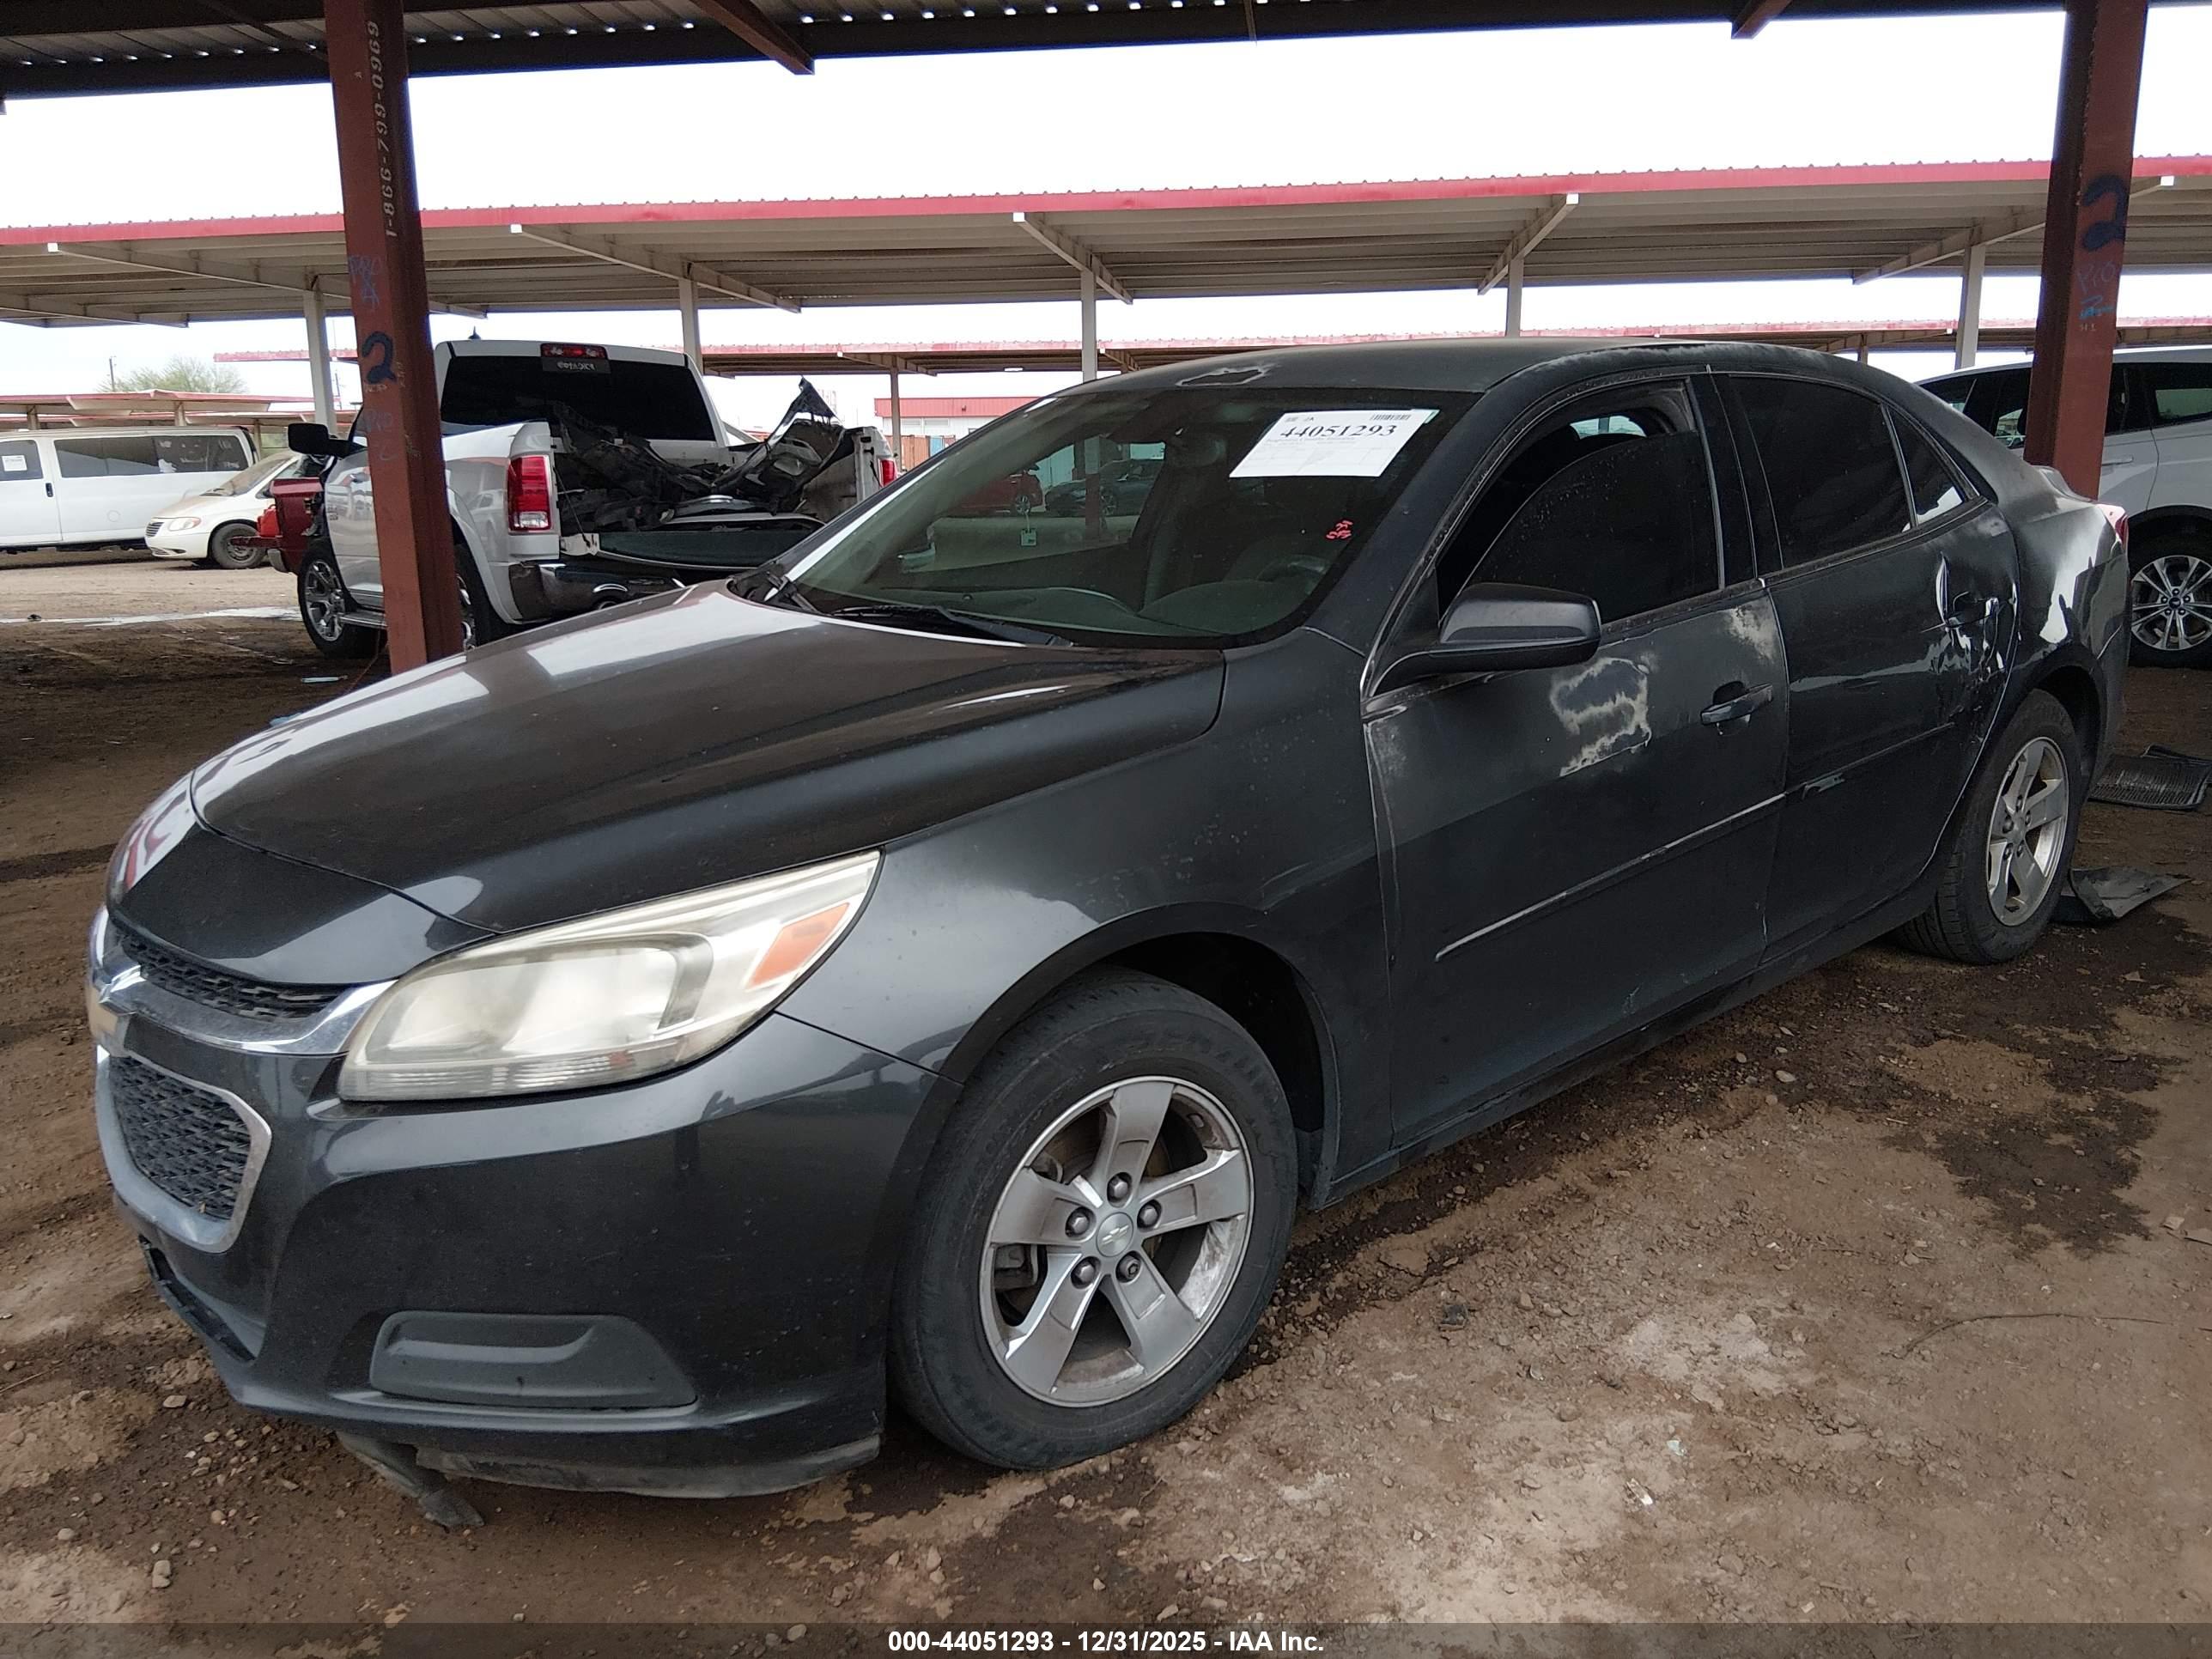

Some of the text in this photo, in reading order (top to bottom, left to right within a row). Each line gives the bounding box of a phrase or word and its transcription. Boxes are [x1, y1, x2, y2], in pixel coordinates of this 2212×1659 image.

[367, 20, 398, 238] 1-866-799-0969
[361, 331, 398, 384] 2
[1279, 423, 1398, 438] 44051293
